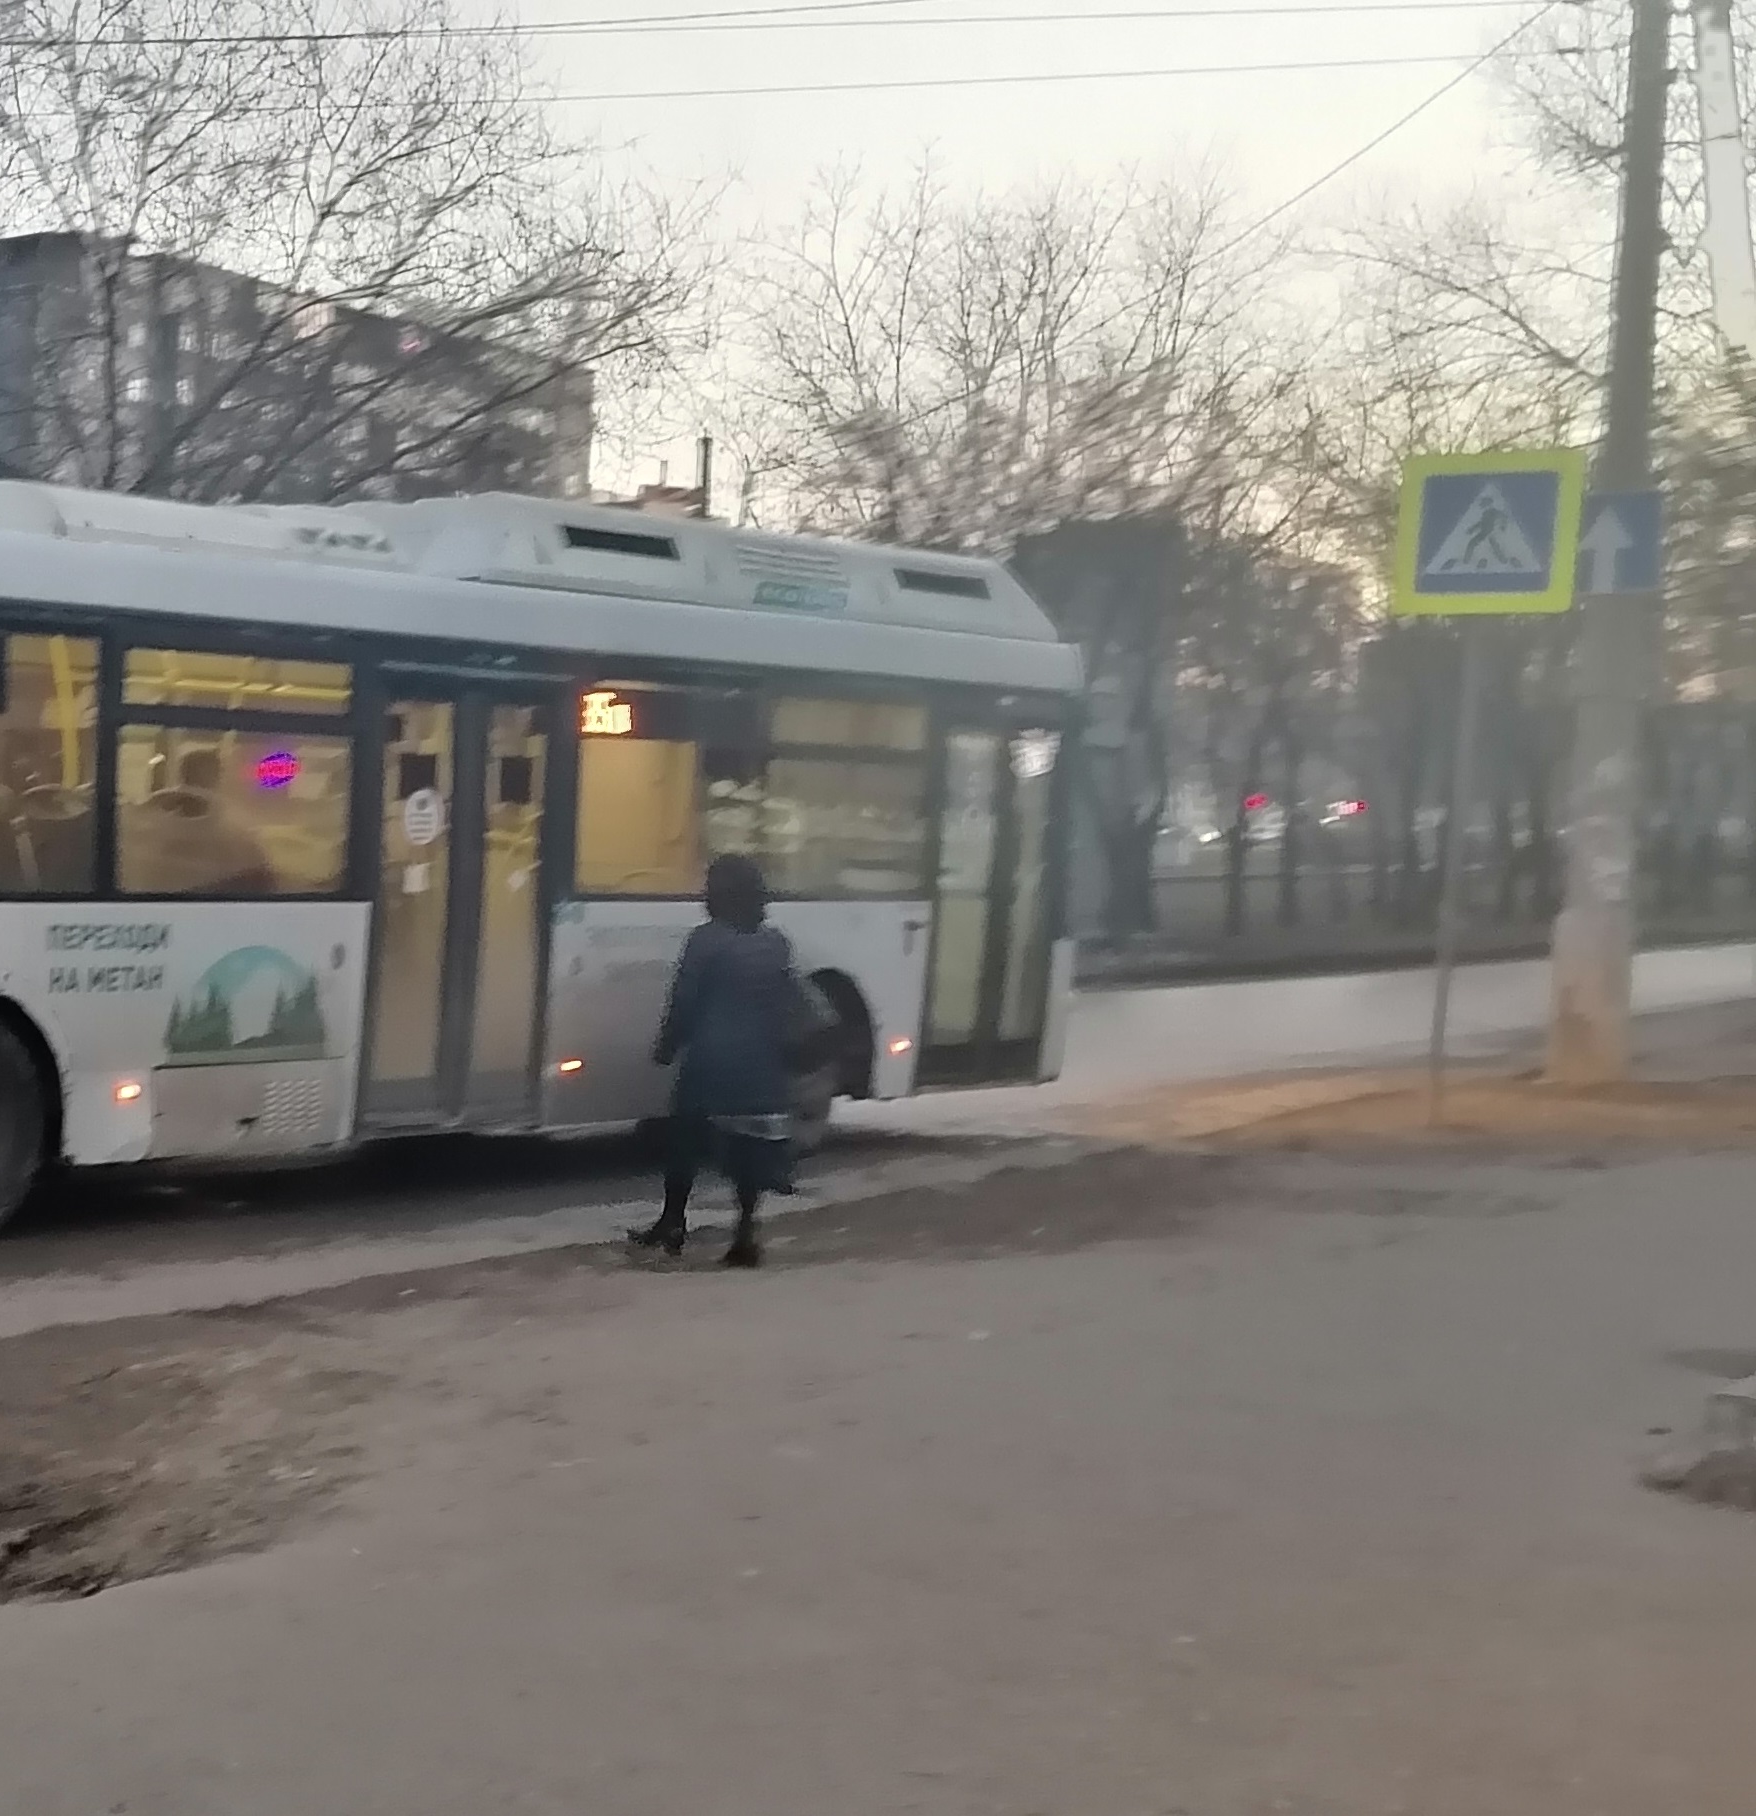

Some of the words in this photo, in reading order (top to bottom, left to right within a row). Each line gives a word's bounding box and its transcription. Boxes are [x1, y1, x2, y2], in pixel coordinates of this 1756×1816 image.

[47, 923, 172, 954] ПЕРЕХОДИ
[49, 966, 79, 994] НА
[87, 965, 164, 993] МЕТАН
